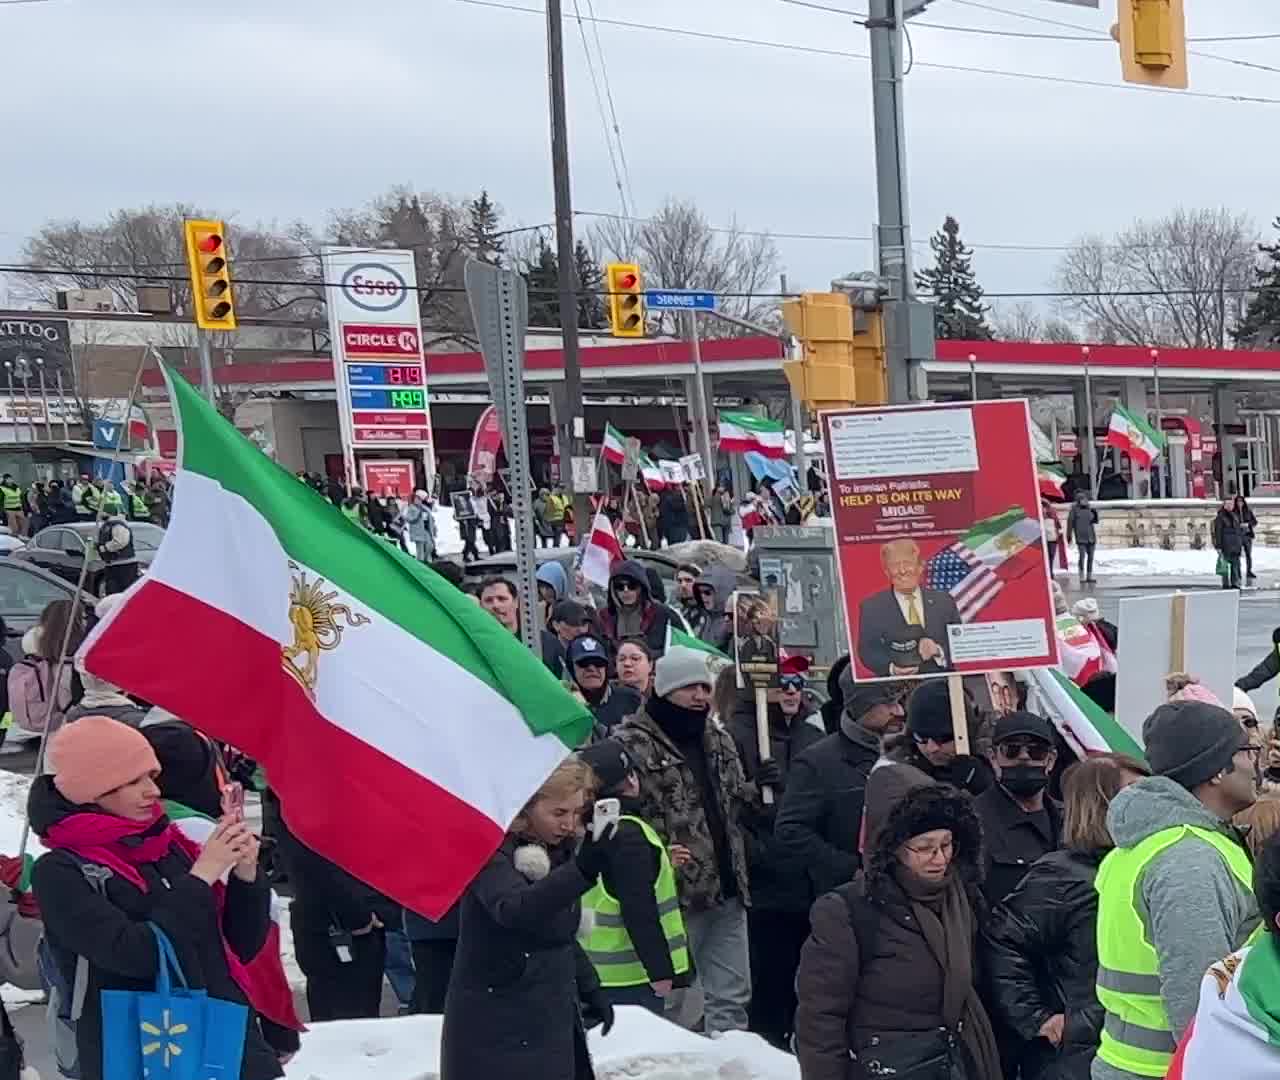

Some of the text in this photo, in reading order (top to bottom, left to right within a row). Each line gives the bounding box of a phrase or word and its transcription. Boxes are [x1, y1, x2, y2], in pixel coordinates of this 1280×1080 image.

[352, 276, 398, 296] Esso
[346, 333, 398, 347] CIRCLE
[840, 494, 873, 507] HELP
[876, 493, 889, 505] IS
[891, 491, 910, 504] ON
[935, 488, 963, 500] WAY
